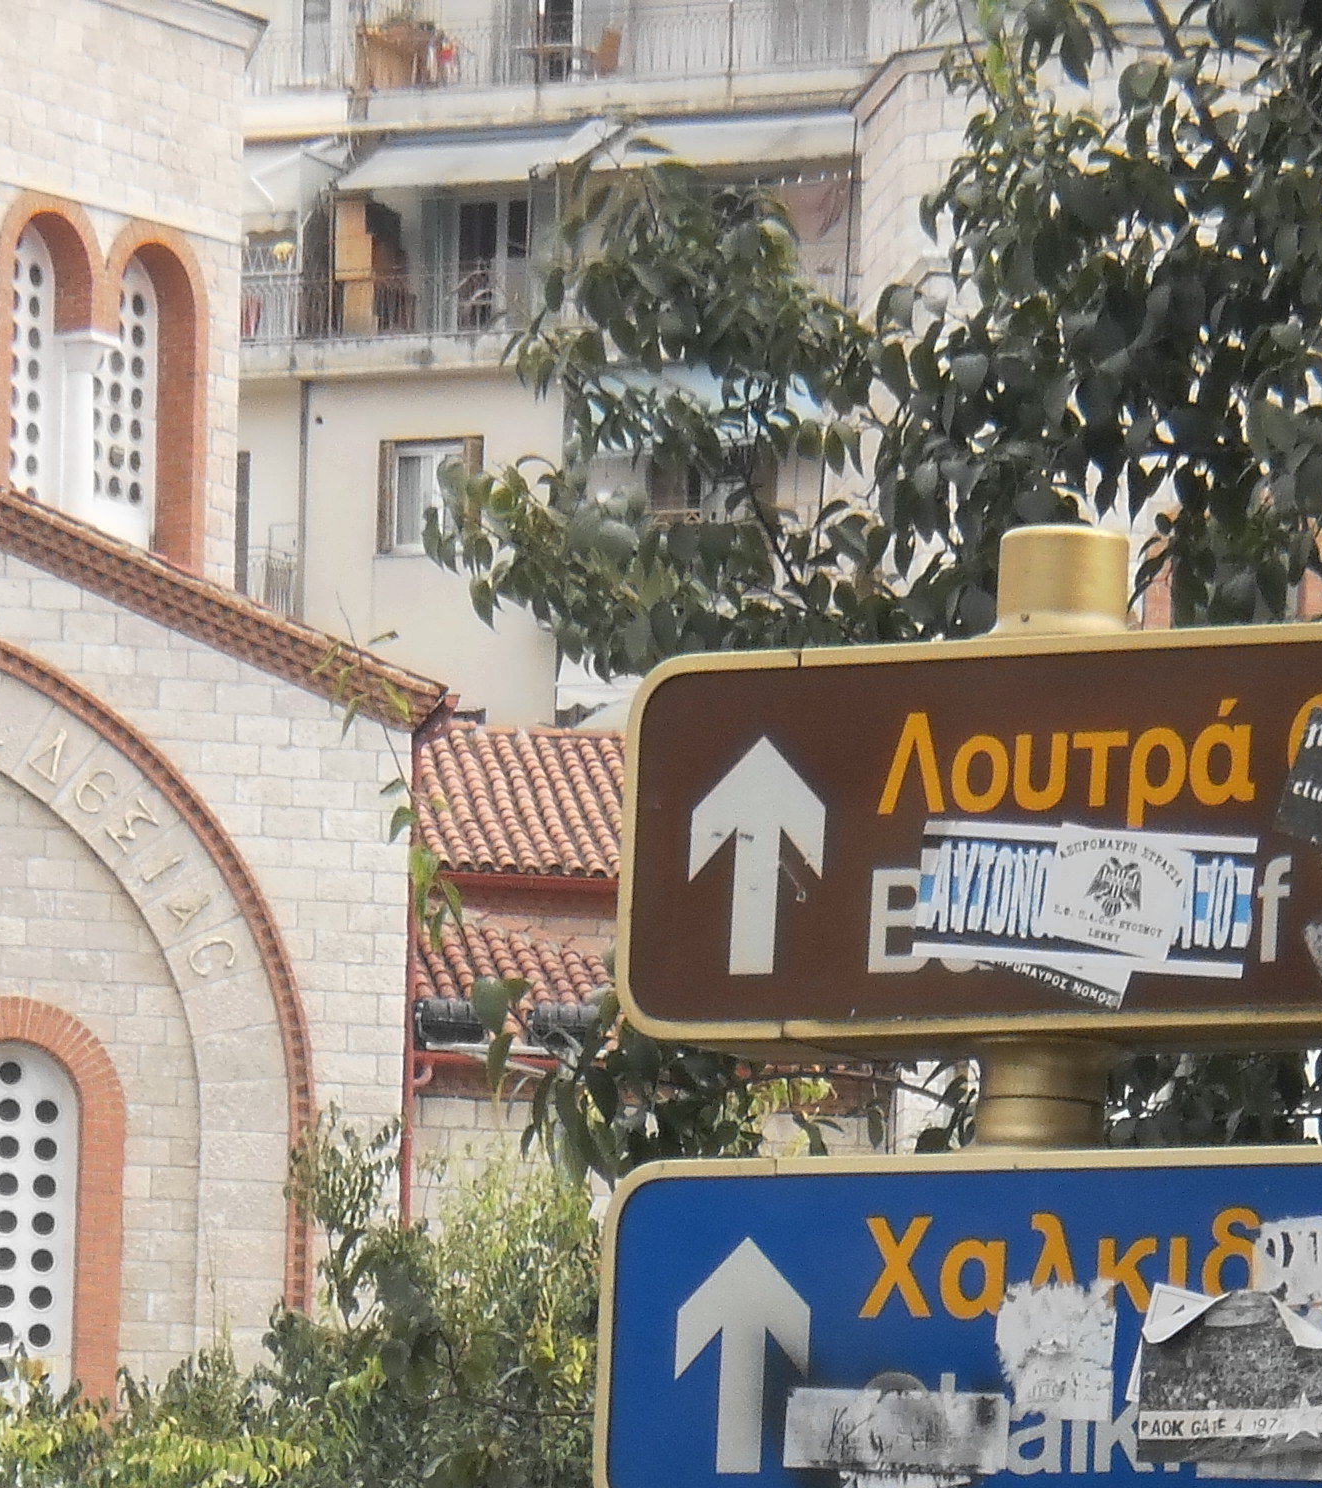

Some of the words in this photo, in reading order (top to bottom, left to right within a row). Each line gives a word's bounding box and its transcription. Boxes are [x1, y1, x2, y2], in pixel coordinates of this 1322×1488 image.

[877, 697, 1256, 828] Λουτρά
[928, 840, 1055, 939] ΑΥΤΟΝΟ
[1141, 1418, 1185, 1437] PAOK
[1190, 1416, 1227, 1437] GATE
